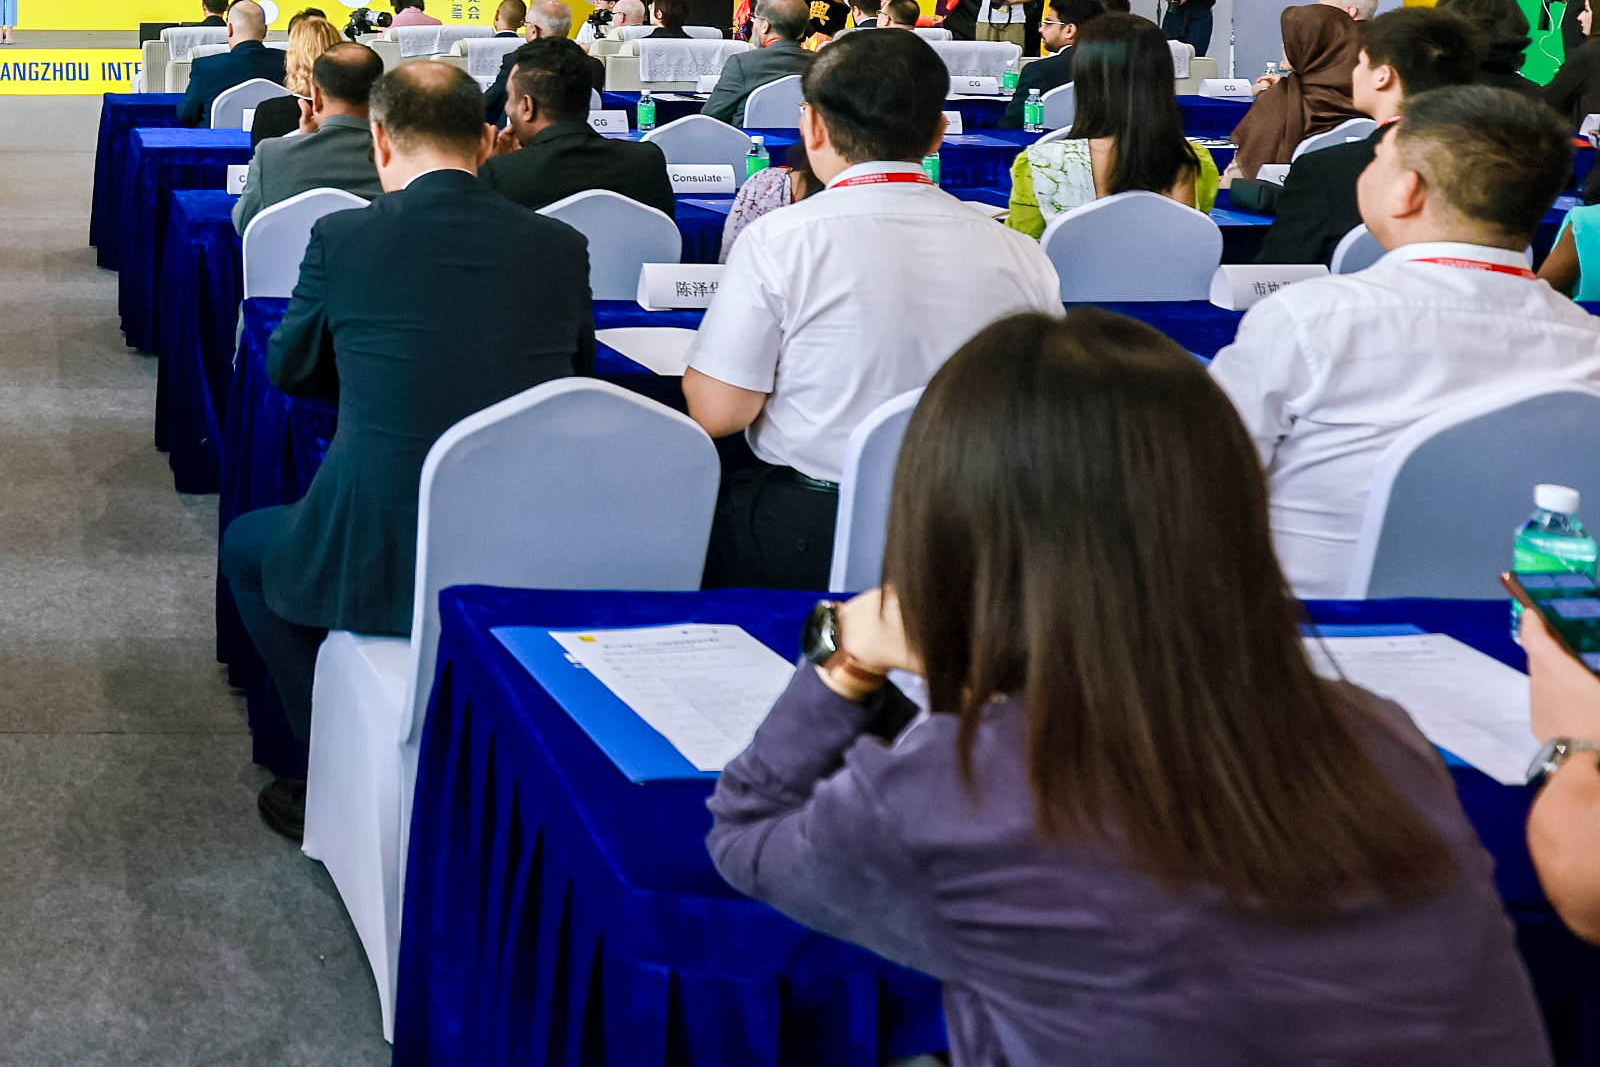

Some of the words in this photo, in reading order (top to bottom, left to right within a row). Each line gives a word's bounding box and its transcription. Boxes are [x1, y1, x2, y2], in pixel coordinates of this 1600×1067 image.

[452, 4, 463, 20] FAIR
[1224, 84, 1236, 92] CG
[593, 118, 608, 127] CG
[672, 173, 722, 182] Consulate
